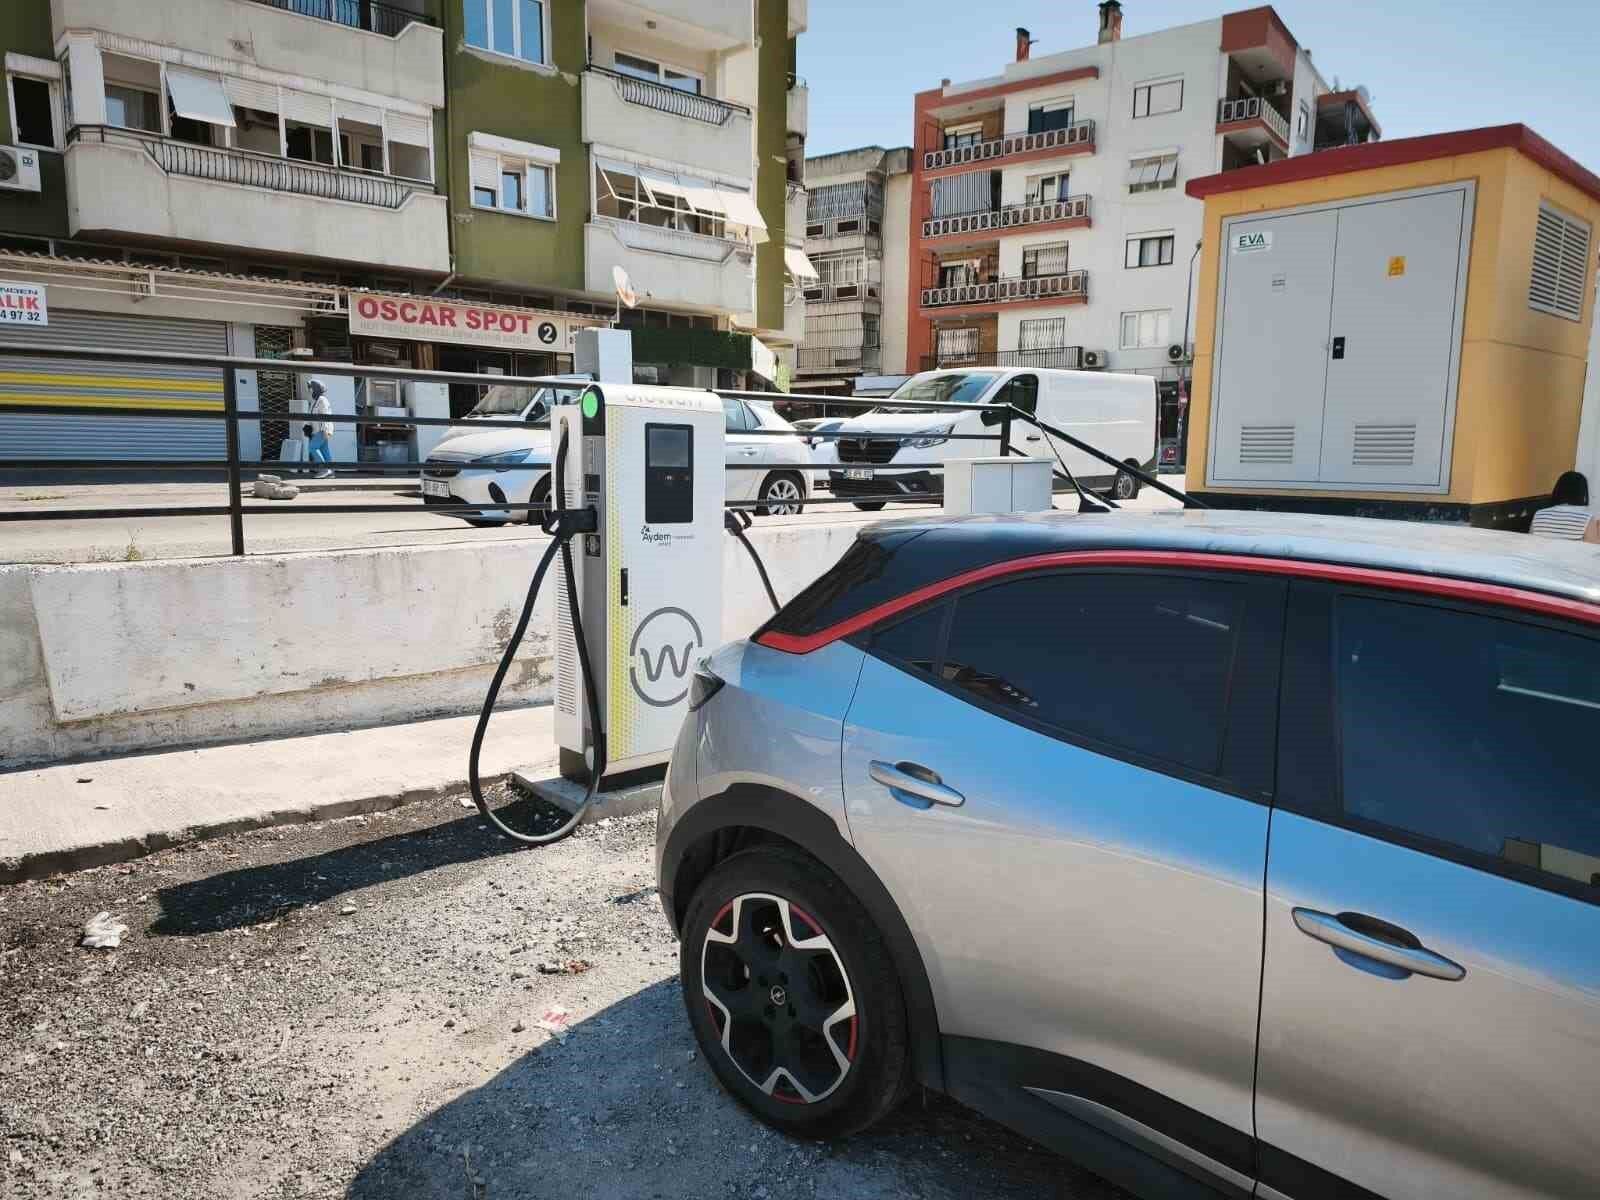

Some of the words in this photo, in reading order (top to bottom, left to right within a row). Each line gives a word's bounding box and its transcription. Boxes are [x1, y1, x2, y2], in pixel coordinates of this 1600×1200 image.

[1239, 233, 1265, 246] EVA
[10, 310, 23, 320] 97
[27, 311, 41, 321] 32
[357, 298, 457, 327] OSCAR
[465, 309, 533, 334] SPOT
[642, 532, 672, 543] Aydem
